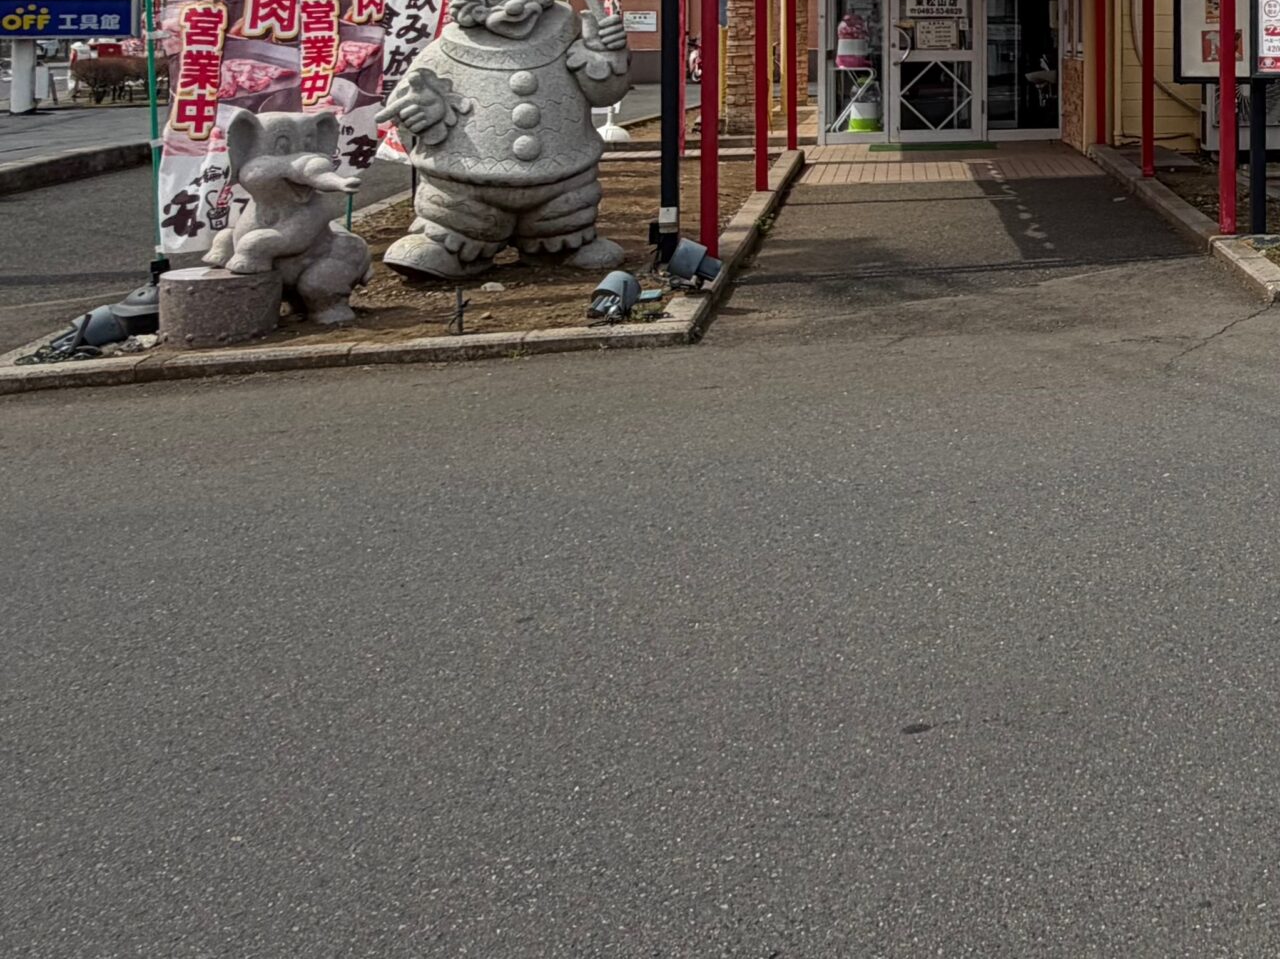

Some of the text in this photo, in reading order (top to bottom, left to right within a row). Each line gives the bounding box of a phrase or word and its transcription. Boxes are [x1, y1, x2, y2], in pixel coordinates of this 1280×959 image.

[2, 14, 51, 30] OFF
[58, 14, 120, 30] 工具館
